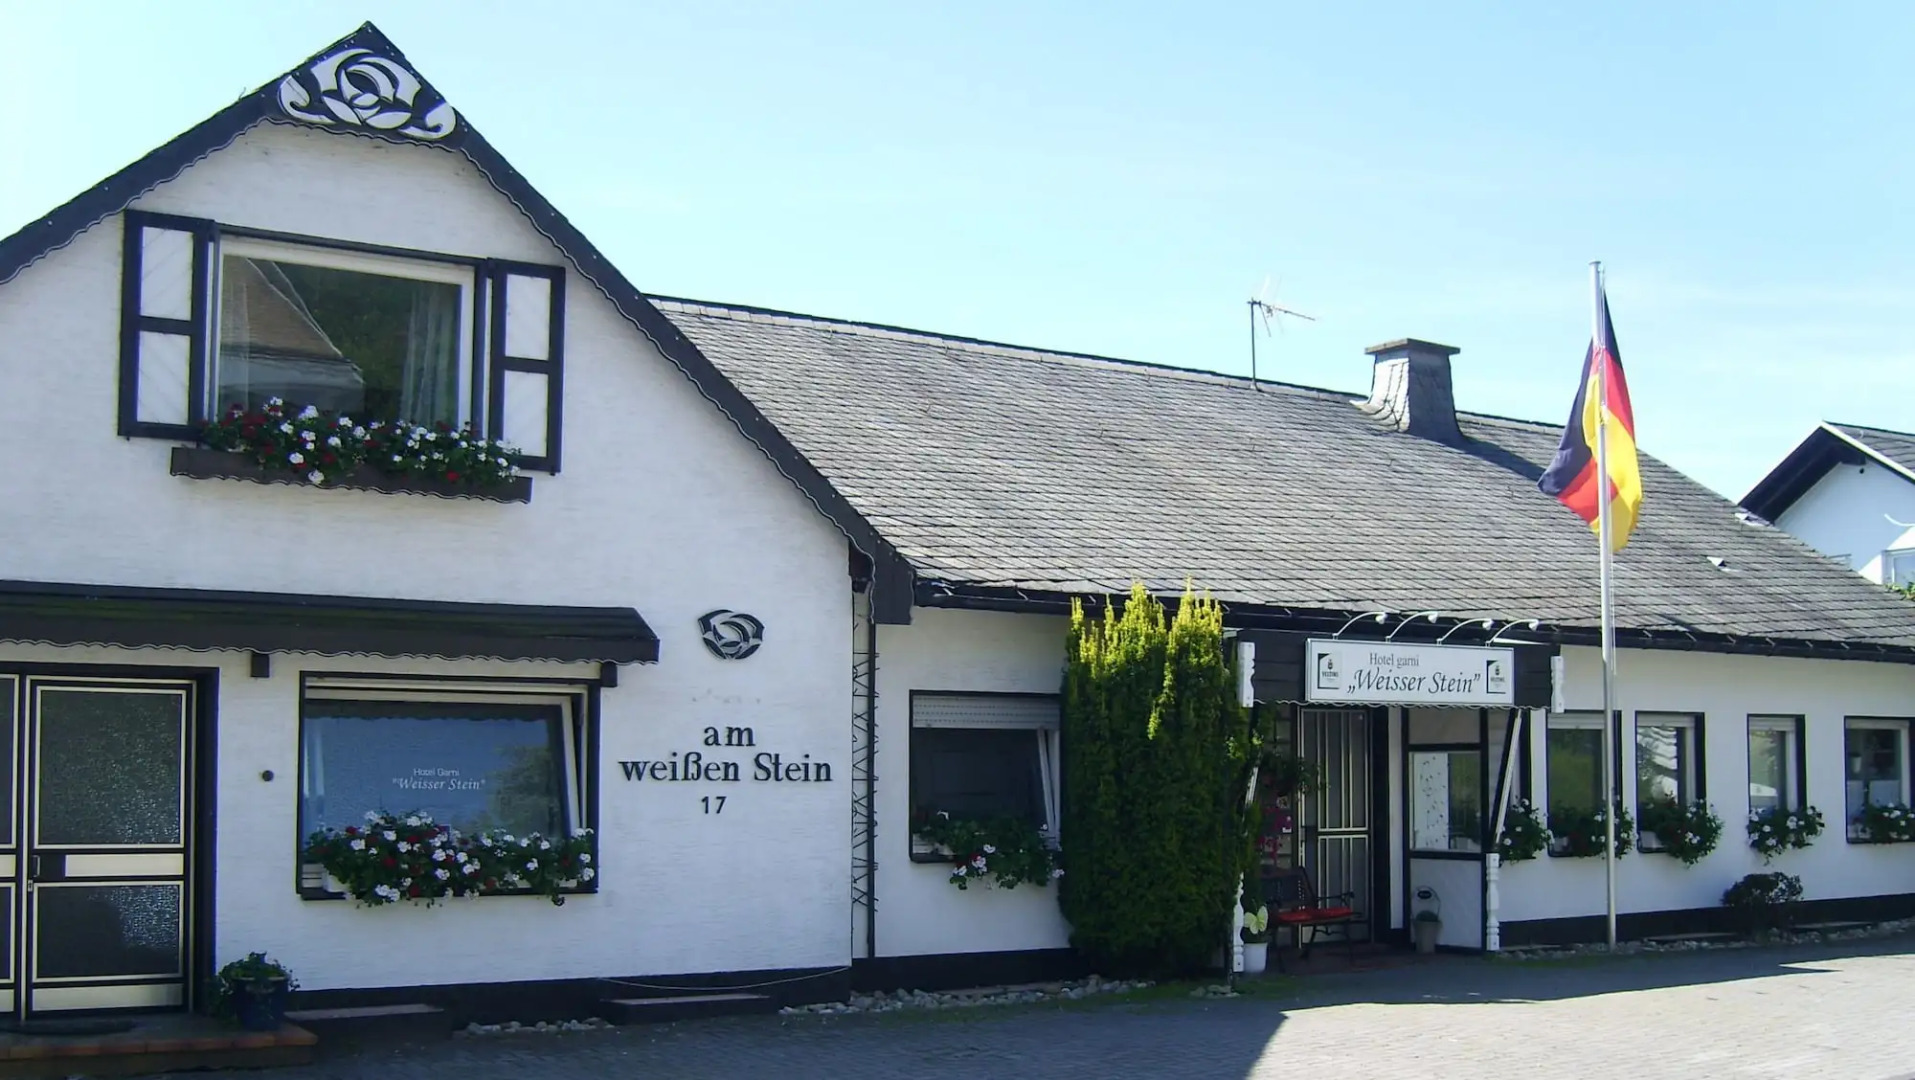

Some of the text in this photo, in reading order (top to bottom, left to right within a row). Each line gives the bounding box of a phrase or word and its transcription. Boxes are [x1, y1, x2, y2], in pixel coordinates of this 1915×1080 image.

[1369, 652, 1419, 668] Hotel garni
[703, 726, 756, 747] am
[413, 768, 459, 776] Hotel Garni
[618, 752, 833, 782] weißen Stein
[701, 796, 727, 814] 17
